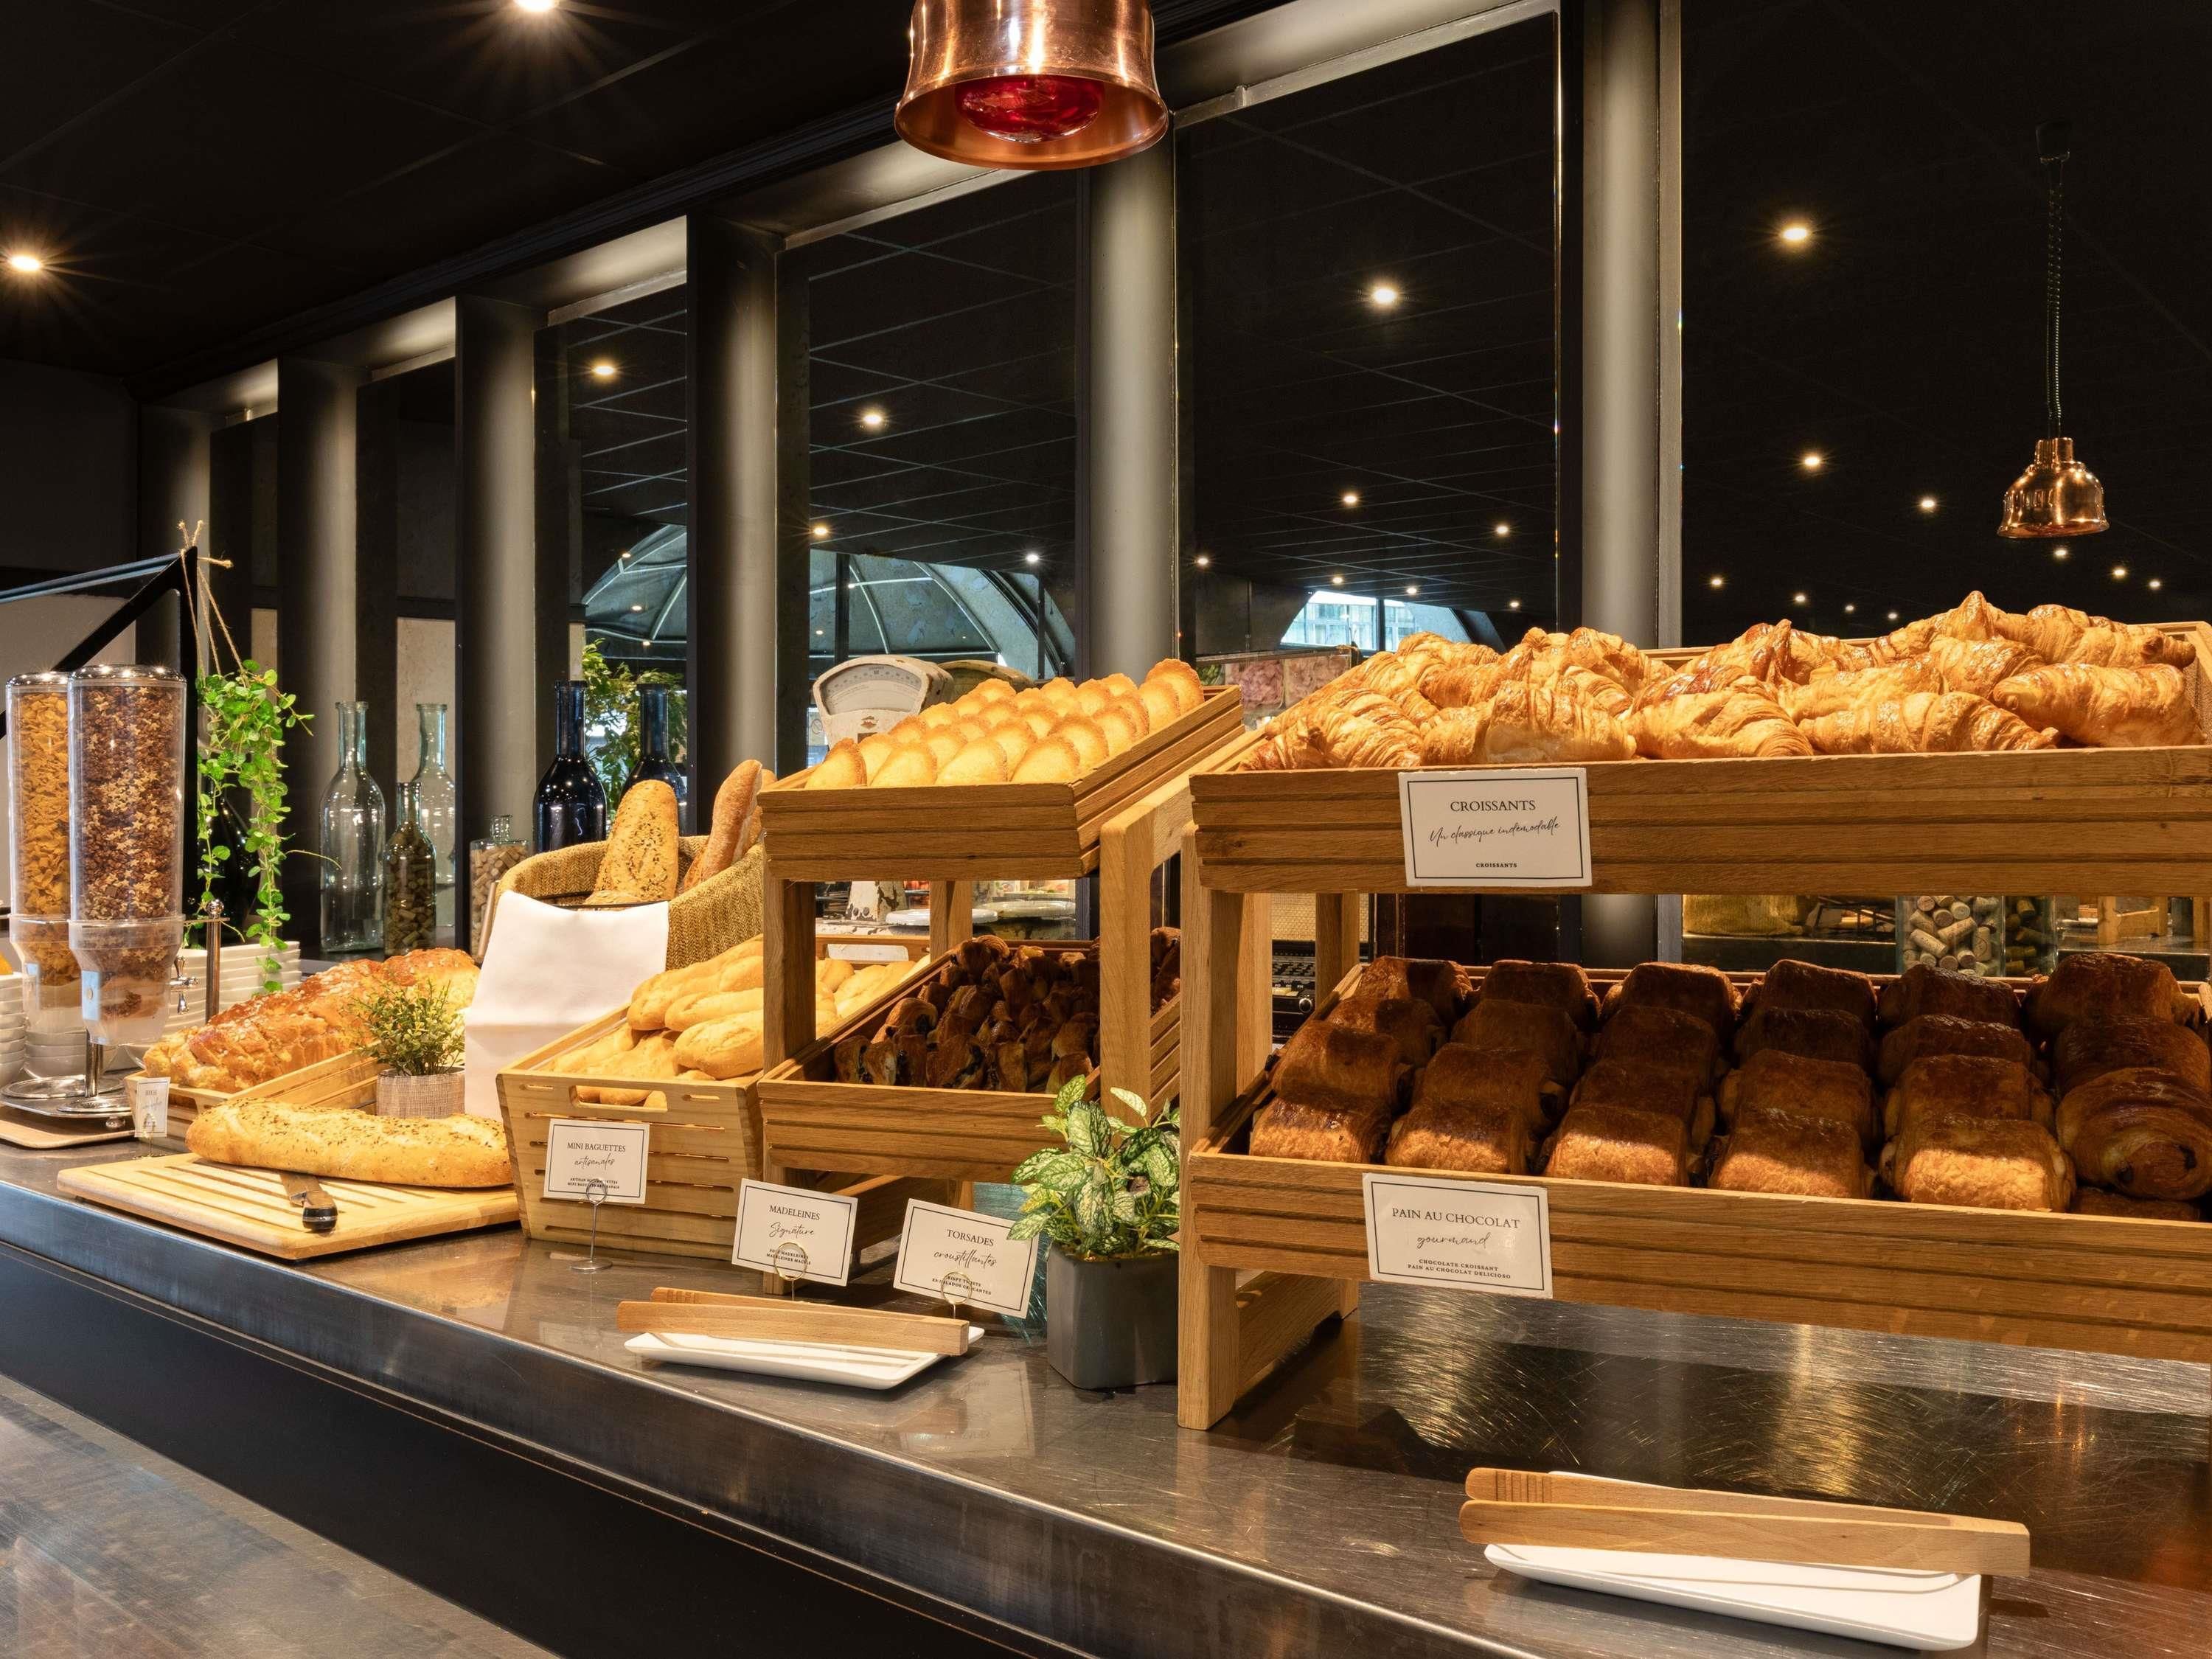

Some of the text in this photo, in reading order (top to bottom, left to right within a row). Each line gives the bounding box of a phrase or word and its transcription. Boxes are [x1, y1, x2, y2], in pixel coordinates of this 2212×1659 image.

[1450, 799, 1536, 813] CROISSANTS
[1450, 824, 1496, 843] classique
[567, 1142, 626, 1152] MINI BAGUETTES
[769, 1206, 820, 1220] MADELEINES
[1392, 1208, 1521, 1228] PAIN AU CHOCOLAT
[769, 1222, 814, 1238] Signature
[946, 1228, 994, 1246] TORSADES
[1416, 1232, 1493, 1249] gourmand
[933, 1249, 997, 1268] croustillantes
[1419, 1259, 1499, 1271] CHOCOLATE CROISSANT
[1436, 1267, 1472, 1276] CHOCOLAT
[1474, 1270, 1511, 1279] DELICIOSO
[962, 1285, 992, 1295] CRCANTES
